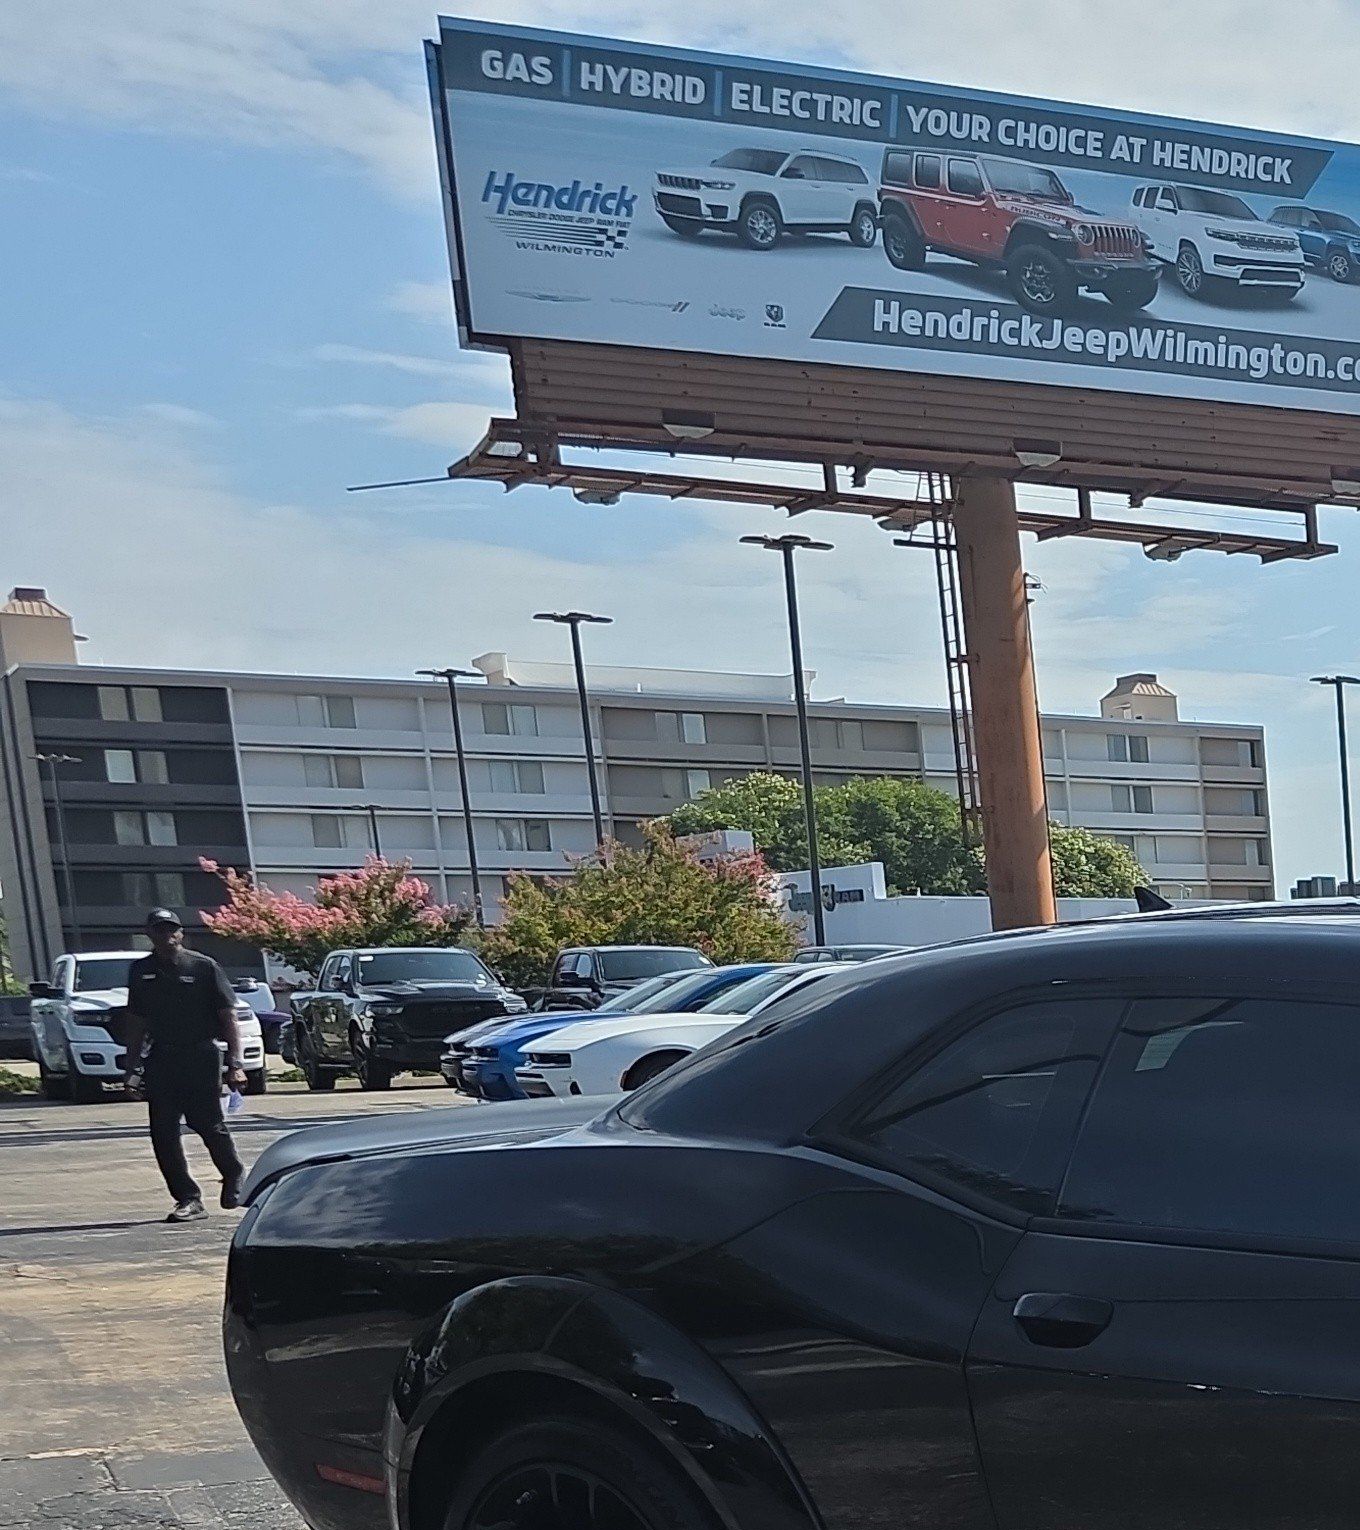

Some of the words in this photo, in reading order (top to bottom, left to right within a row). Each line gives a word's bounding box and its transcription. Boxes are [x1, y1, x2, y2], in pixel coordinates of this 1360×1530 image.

[480, 49, 554, 86] GAS
[580, 62, 706, 105] HYBRID
[730, 82, 882, 128] ELECTRIC
[906, 104, 991, 144] YOUR
[997, 119, 1103, 158] CHOICE
[1109, 134, 1147, 163] AT
[1151, 141, 1292, 185] HENDRICK
[482, 170, 638, 218] Hendrick
[515, 241, 616, 258] WILMINGTON
